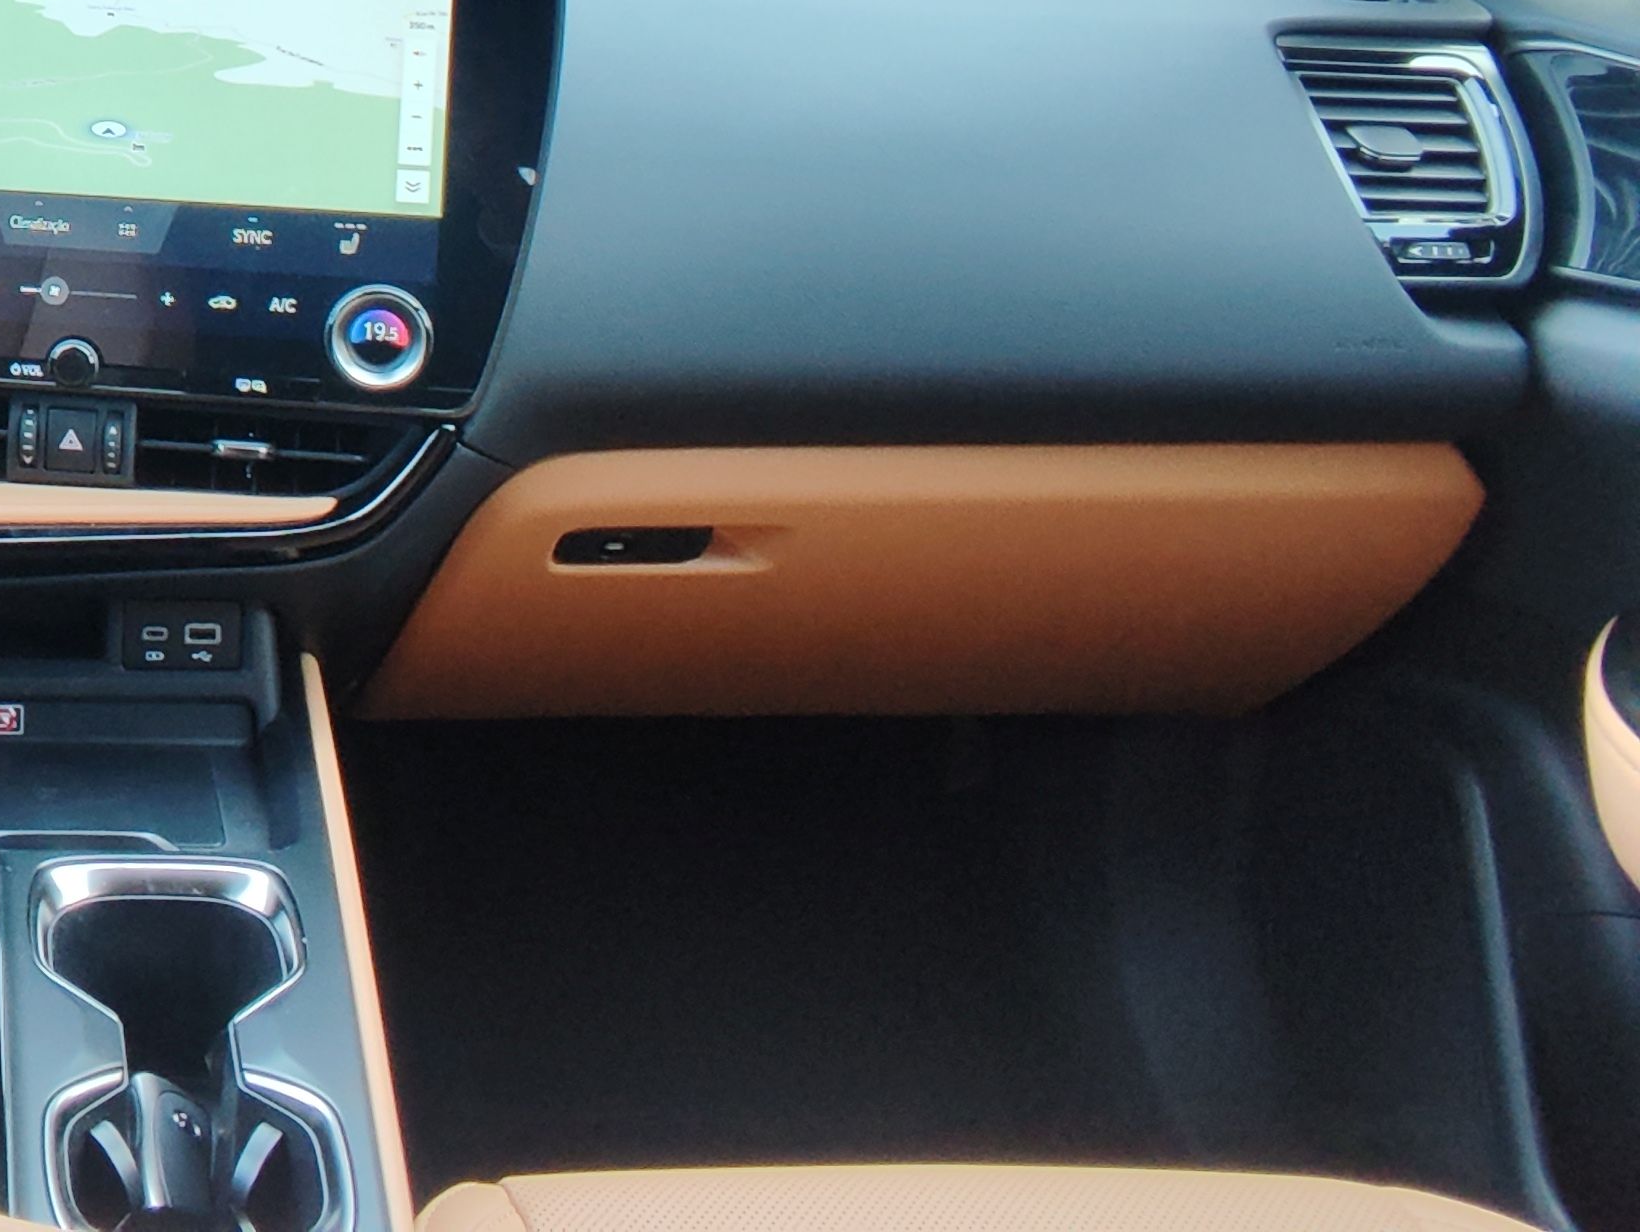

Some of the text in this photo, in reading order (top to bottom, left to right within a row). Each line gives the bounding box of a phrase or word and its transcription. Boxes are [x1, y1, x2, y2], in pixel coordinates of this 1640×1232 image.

[232, 228, 274, 246] SYNC
[269, 296, 298, 314] A/C
[363, 321, 399, 343] 19.5
